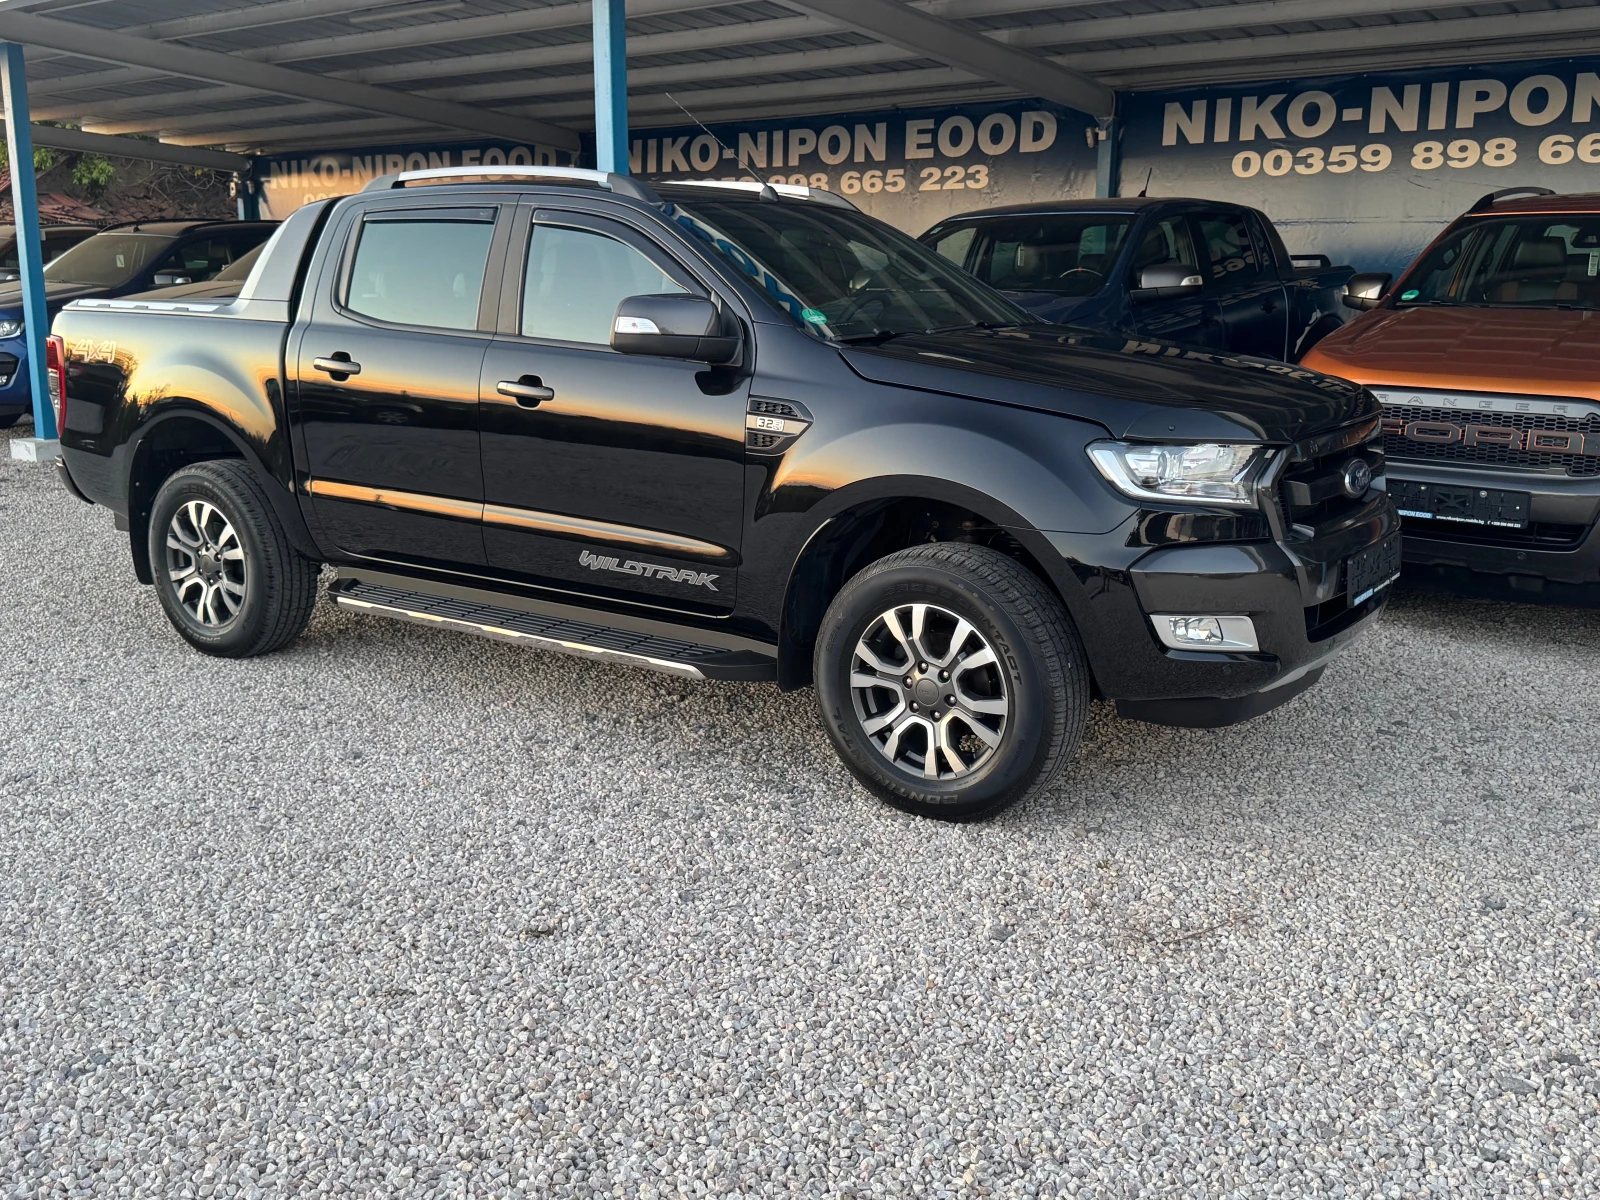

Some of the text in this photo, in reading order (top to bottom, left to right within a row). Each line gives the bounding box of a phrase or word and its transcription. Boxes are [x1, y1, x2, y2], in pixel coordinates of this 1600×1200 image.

[1161, 72, 1600, 147] NIKO-NIPON
[904, 110, 1058, 160] EOOD
[1231, 143, 1393, 179] 00359
[1410, 136, 1518, 171] 898
[839, 169, 906, 195] 665
[919, 164, 990, 191] 223
[1376, 393, 1569, 414] RANGER
[578, 550, 720, 592] WILDTRAK
